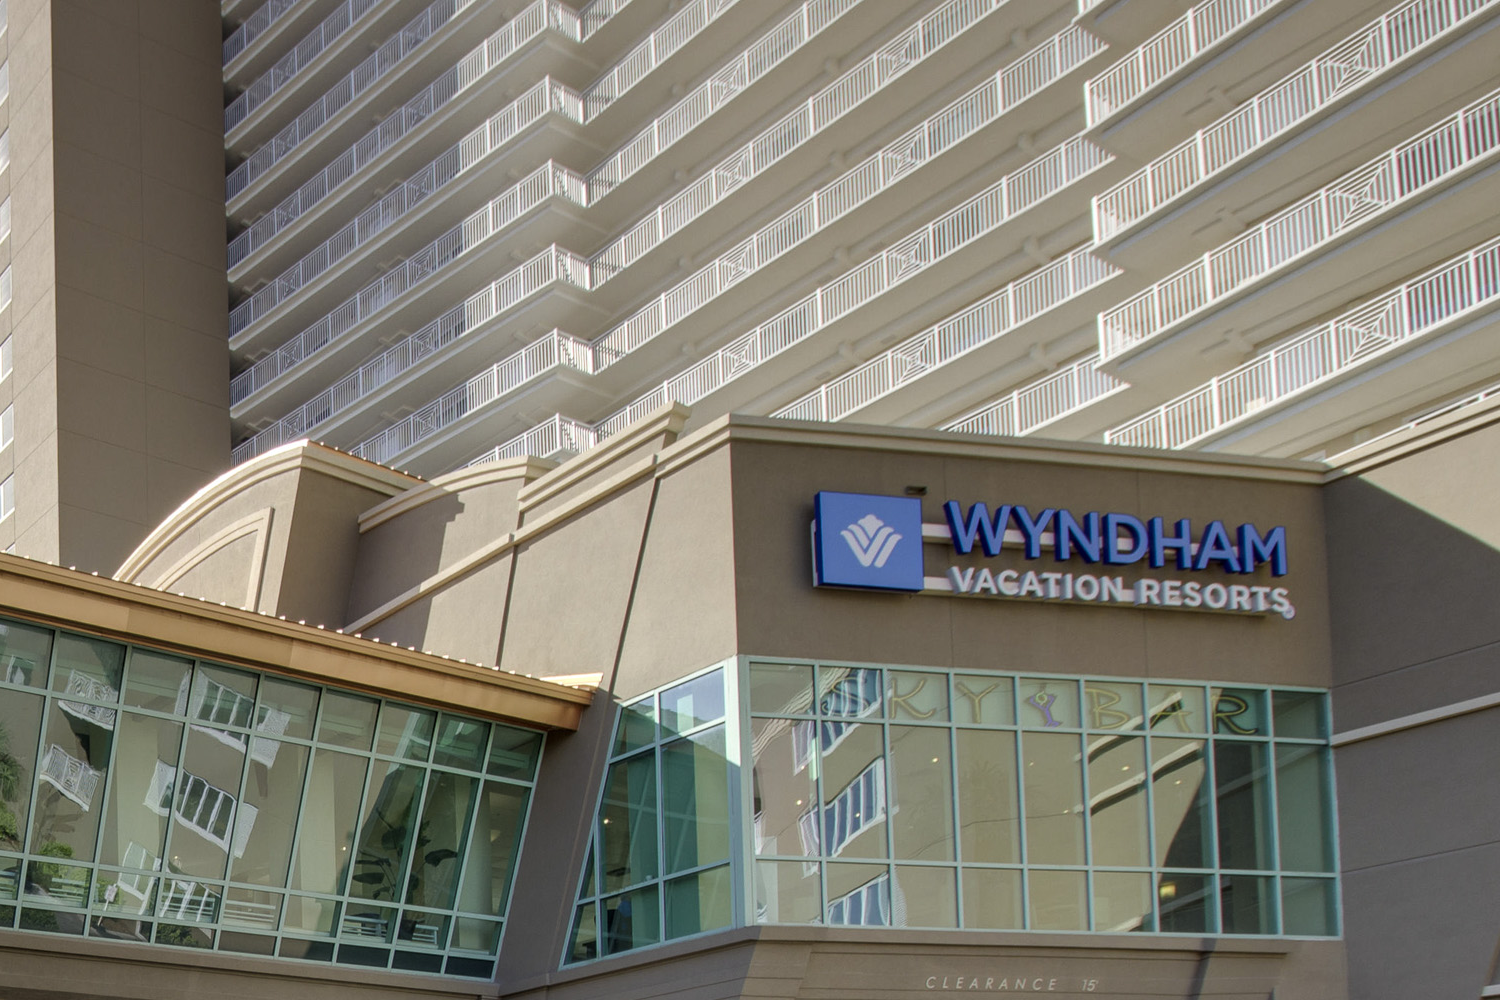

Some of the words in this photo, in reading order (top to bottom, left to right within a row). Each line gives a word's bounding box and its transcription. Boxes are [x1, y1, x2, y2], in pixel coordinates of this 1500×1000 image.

[943, 500, 1288, 577] WYNDHAM
[947, 566, 1123, 602] VACATION
[1134, 578, 1290, 613] RESORTS
[821, 676, 1000, 725] SKY
[1084, 687, 1259, 735] BAR
[925, 976, 1057, 991] CLEARANCE
